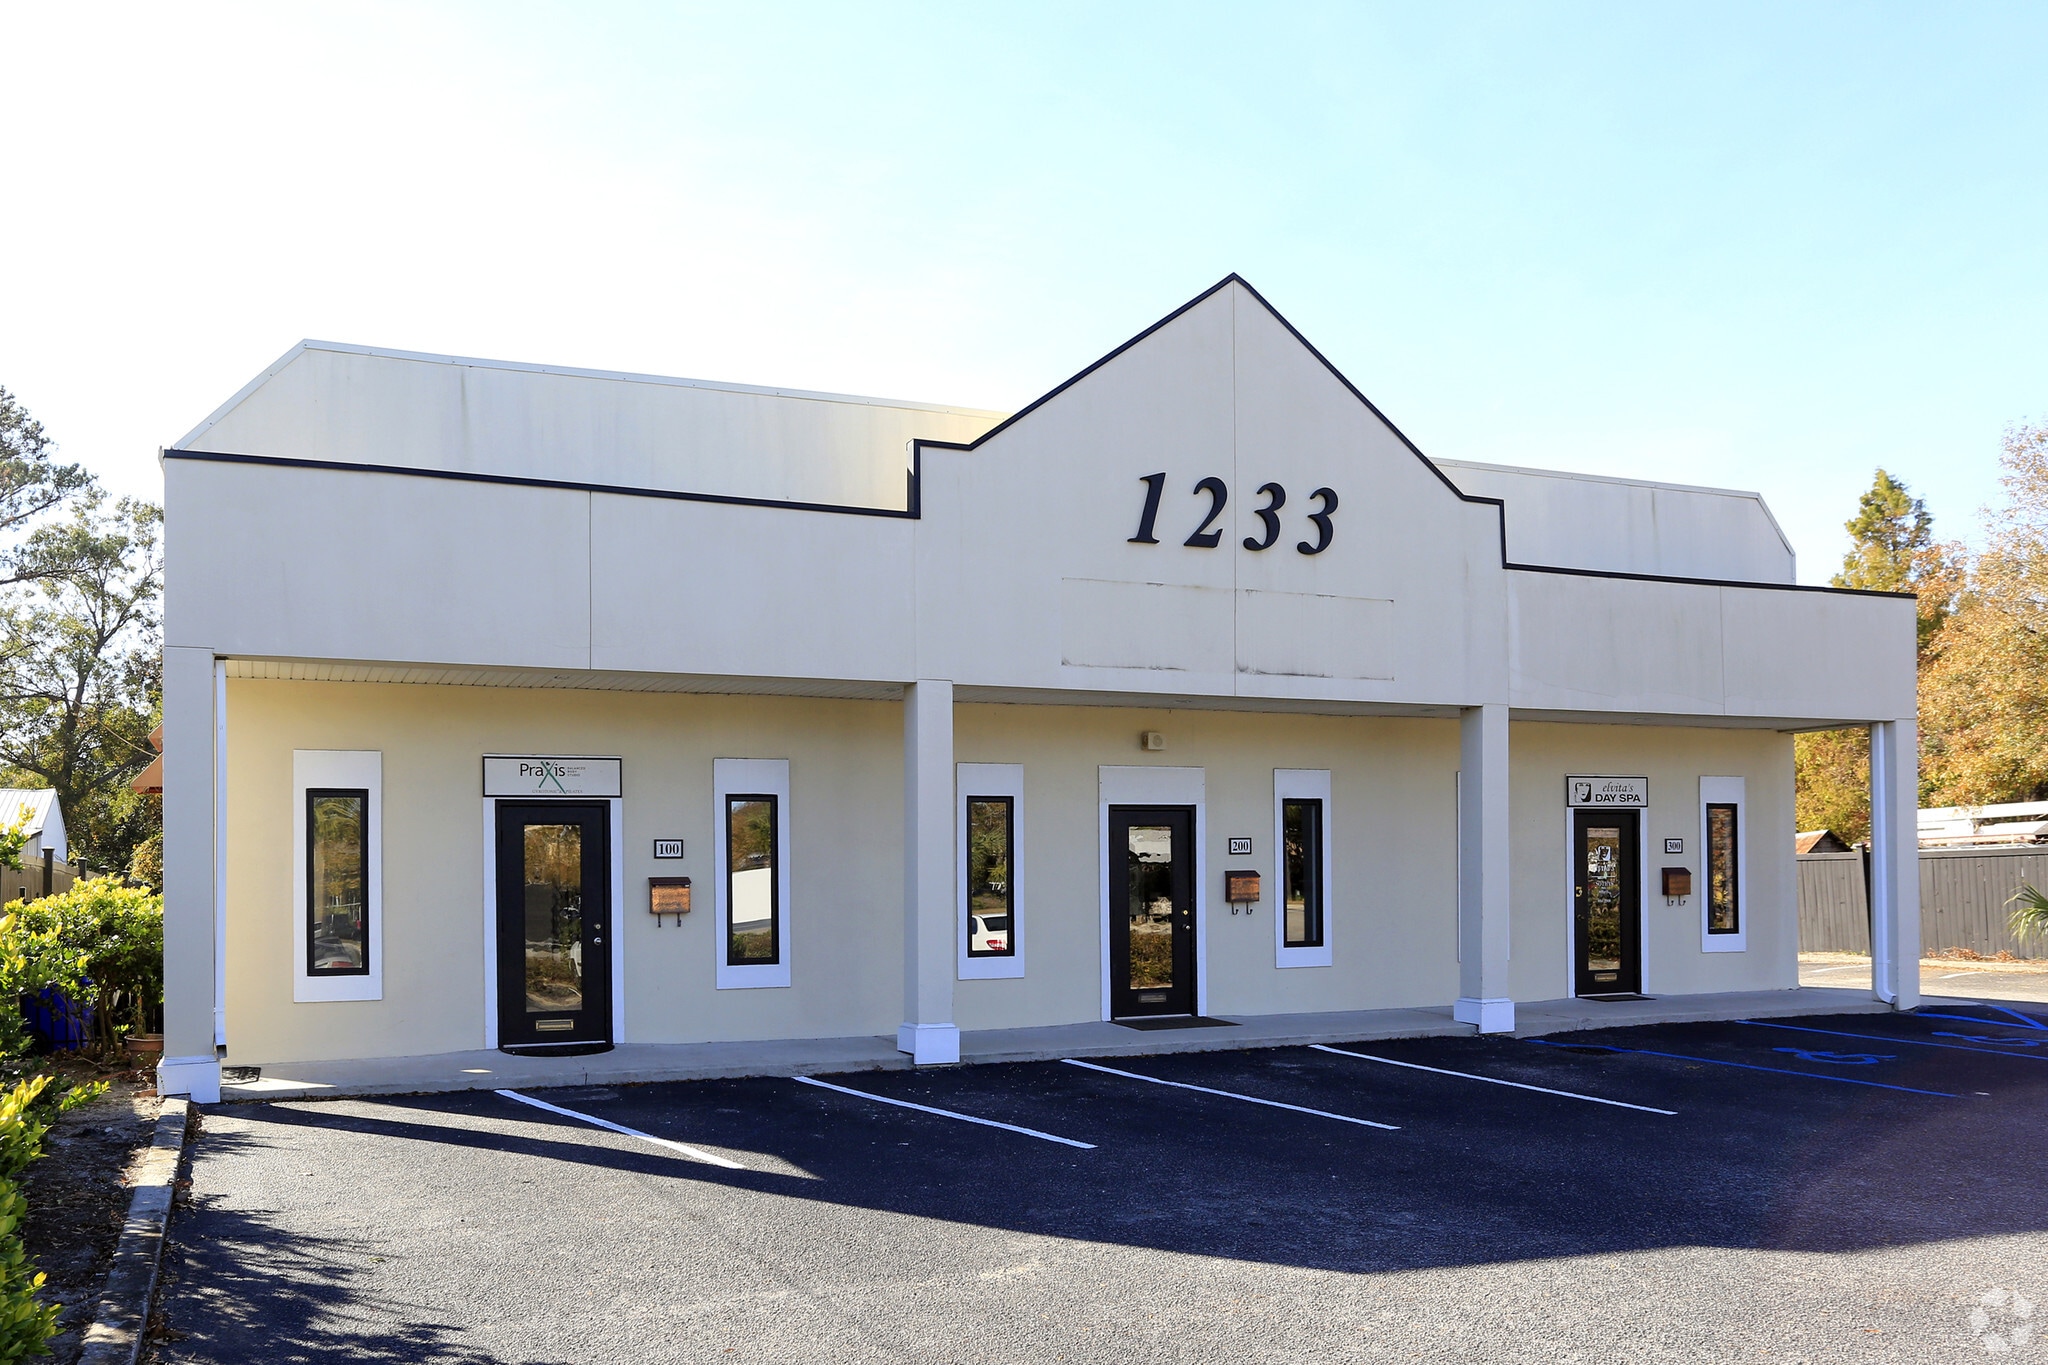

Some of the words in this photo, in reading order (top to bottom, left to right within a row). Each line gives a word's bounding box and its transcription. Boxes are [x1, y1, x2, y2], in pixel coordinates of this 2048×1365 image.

[1126, 471, 1339, 555] 1233
[1602, 781, 1634, 792] elvita's
[1595, 794, 1617, 802] DAY
[1619, 794, 1641, 802] SPA
[658, 843, 680, 855] 100
[1232, 841, 1249, 851] 200
[1667, 841, 1681, 851] 300
